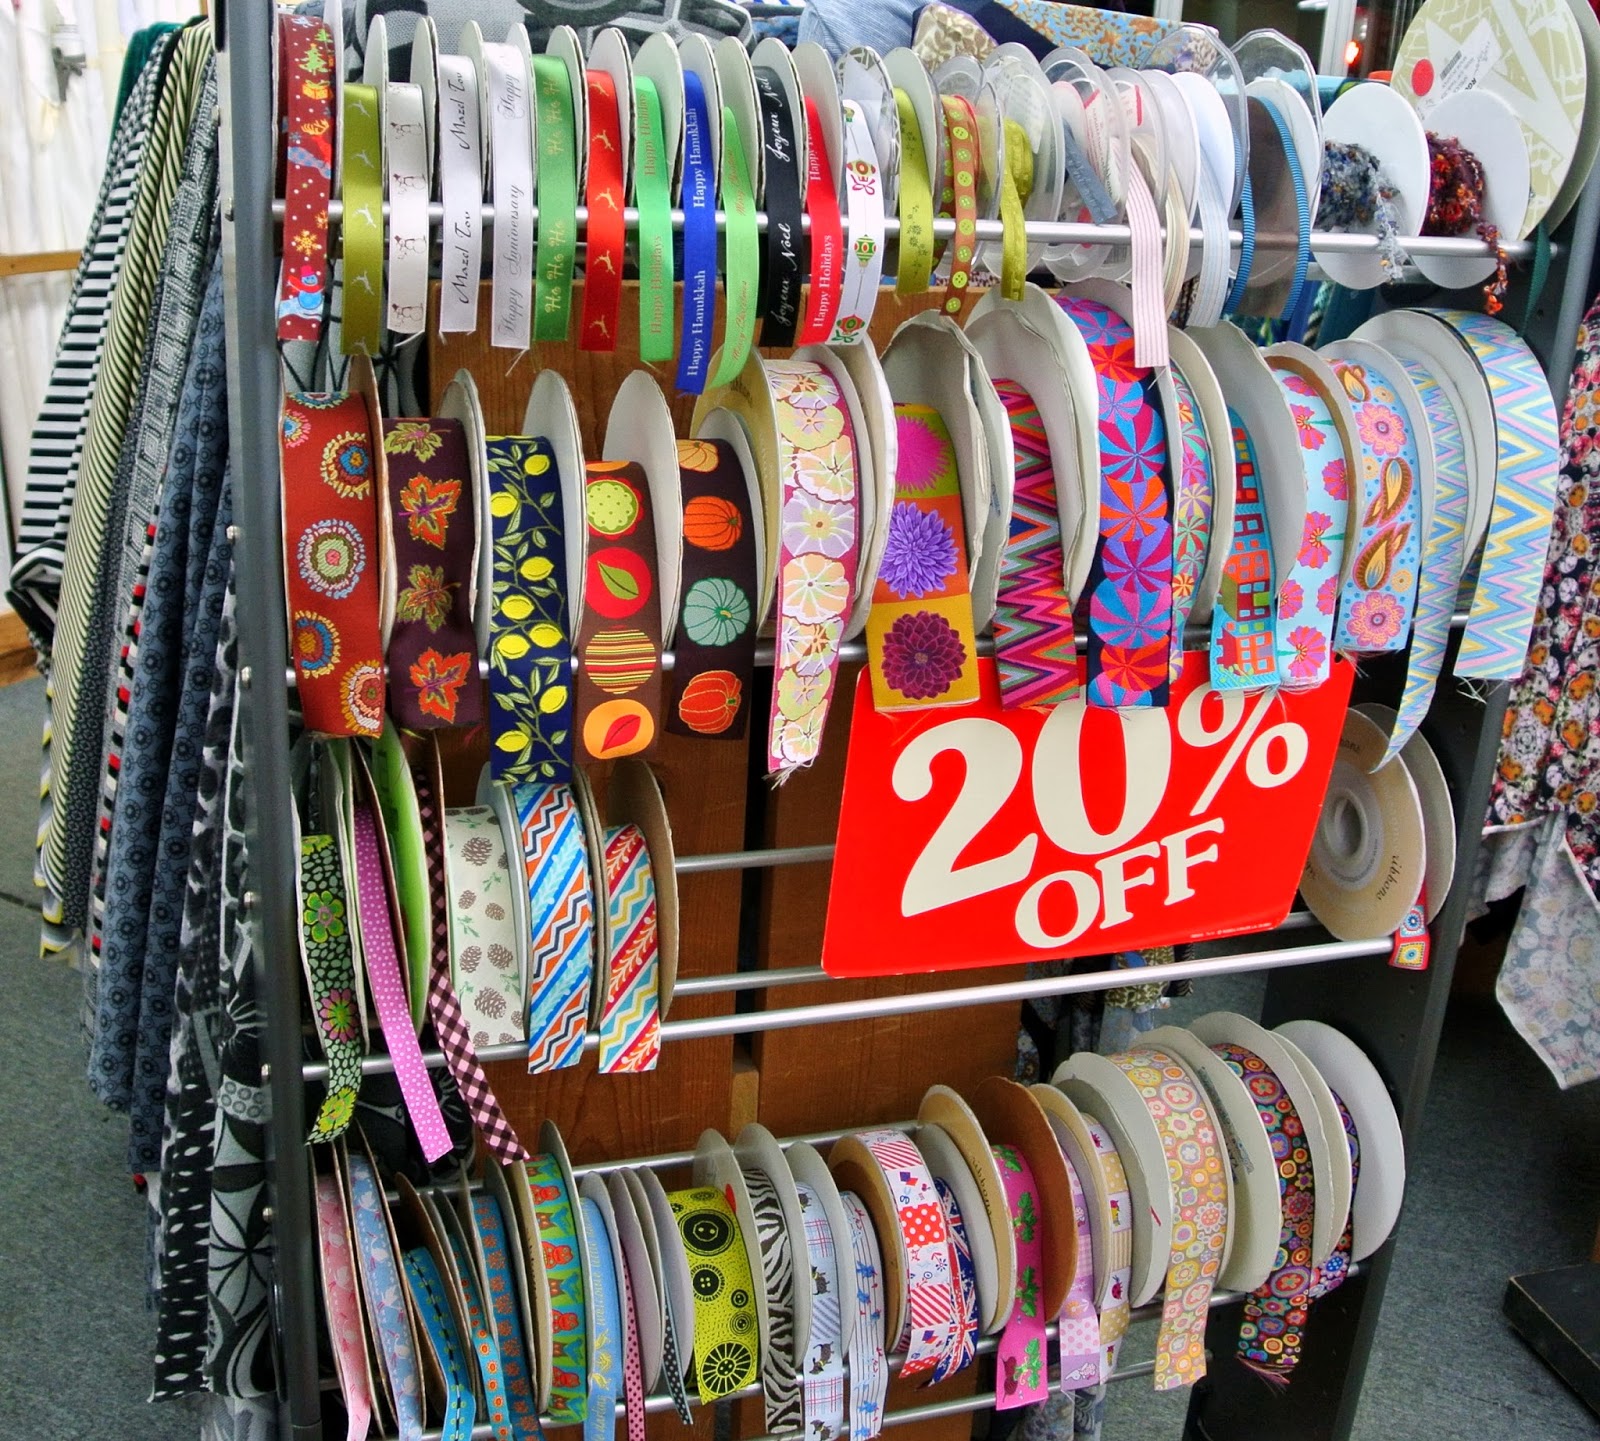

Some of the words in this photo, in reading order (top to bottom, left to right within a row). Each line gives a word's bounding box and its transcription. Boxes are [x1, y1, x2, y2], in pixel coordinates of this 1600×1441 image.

[447, 72, 466, 92] Tov
[497, 73, 526, 120] Happy
[449, 98, 470, 150] Mazel
[685, 107, 702, 165] Hanukkah
[765, 111, 791, 163] Joyeux
[644, 140, 656, 176] Happy
[809, 150, 822, 180] Happy
[692, 167, 707, 208] Happy
[454, 211, 472, 239] Tov
[503, 184, 525, 276] Anniversary
[548, 220, 567, 247] Ho
[450, 245, 470, 305] Mazel
[546, 253, 565, 280] Ho
[649, 235, 664, 290] Holidays
[818, 235, 834, 289] Holidays
[498, 288, 524, 340] Happy
[544, 286, 562, 314] Ho
[649, 293, 664, 335] Happy
[691, 269, 706, 335] Hanukkah
[770, 276, 795, 327] Joyeux
[812, 292, 832, 328] Happy
[686, 337, 705, 376] Happy
[731, 331, 746, 362] Merry
[891, 681, 1309, 918] 20%
[1014, 817, 1226, 949] OFF
[1375, 854, 1403, 901] ribbons
